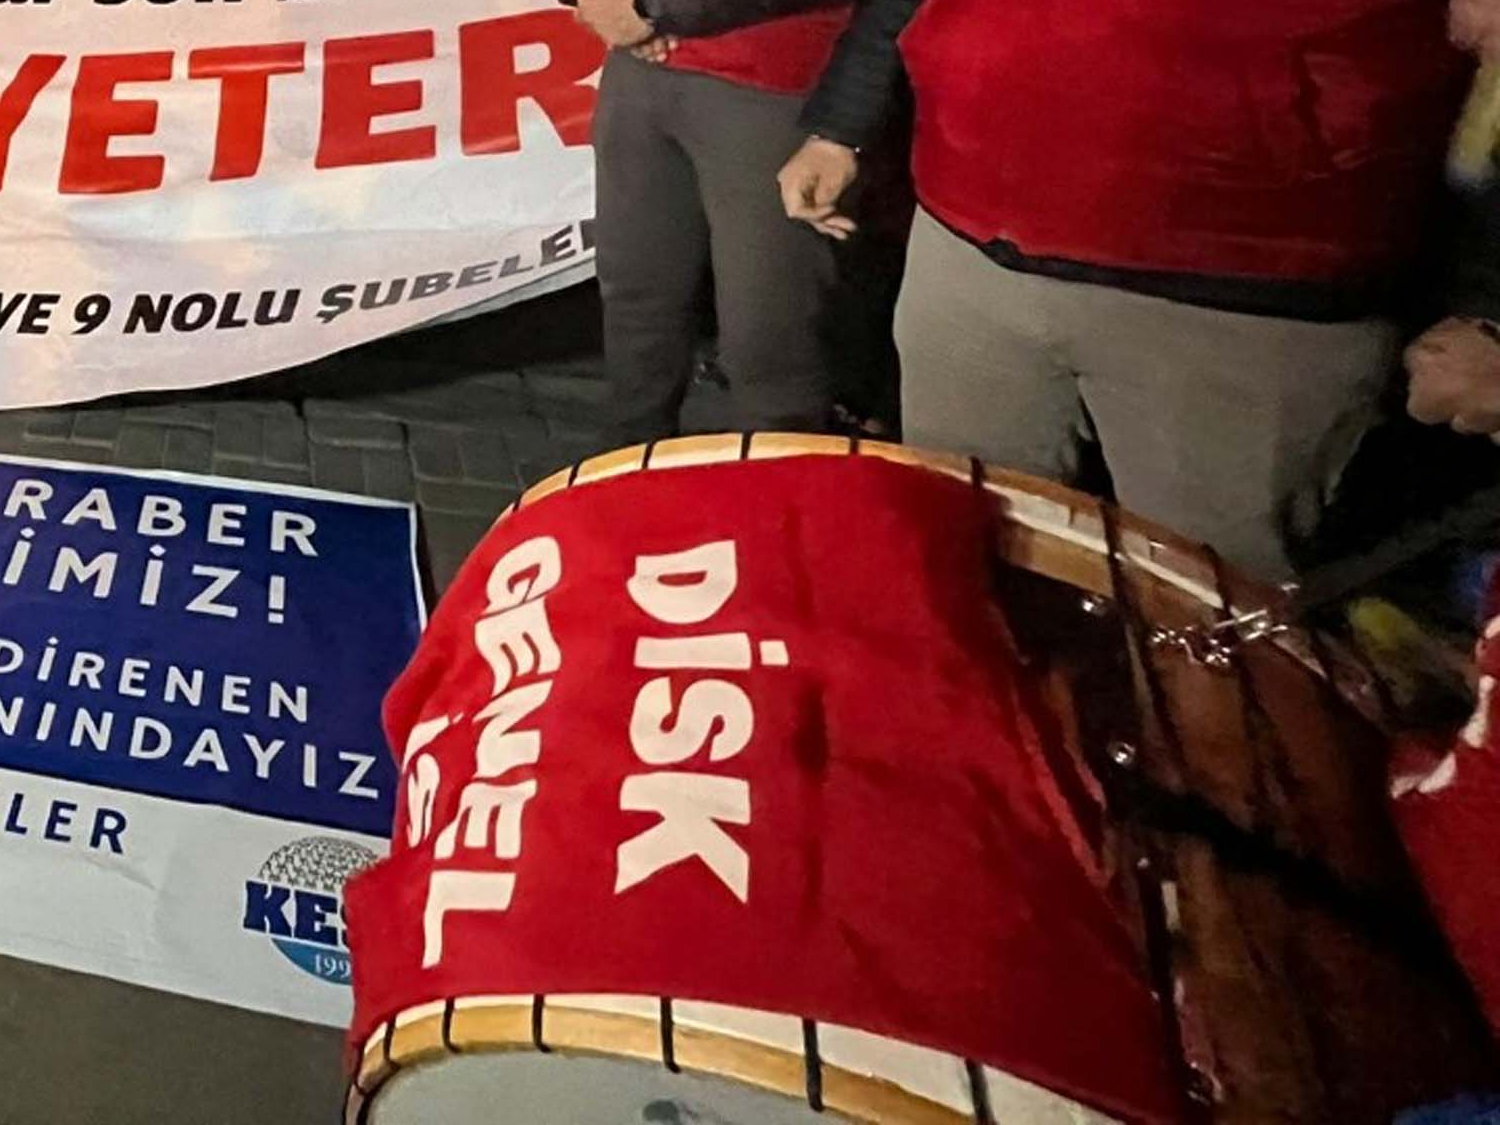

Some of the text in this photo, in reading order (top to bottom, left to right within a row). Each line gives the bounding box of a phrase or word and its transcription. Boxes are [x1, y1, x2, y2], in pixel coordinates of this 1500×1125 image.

[71, 292, 112, 336] 9
[122, 288, 301, 335] NOLU
[421, 535, 562, 970] GENEL
[614, 539, 789, 905] DİSK
[243, 880, 352, 949] KE
[315, 953, 351, 979] 199
